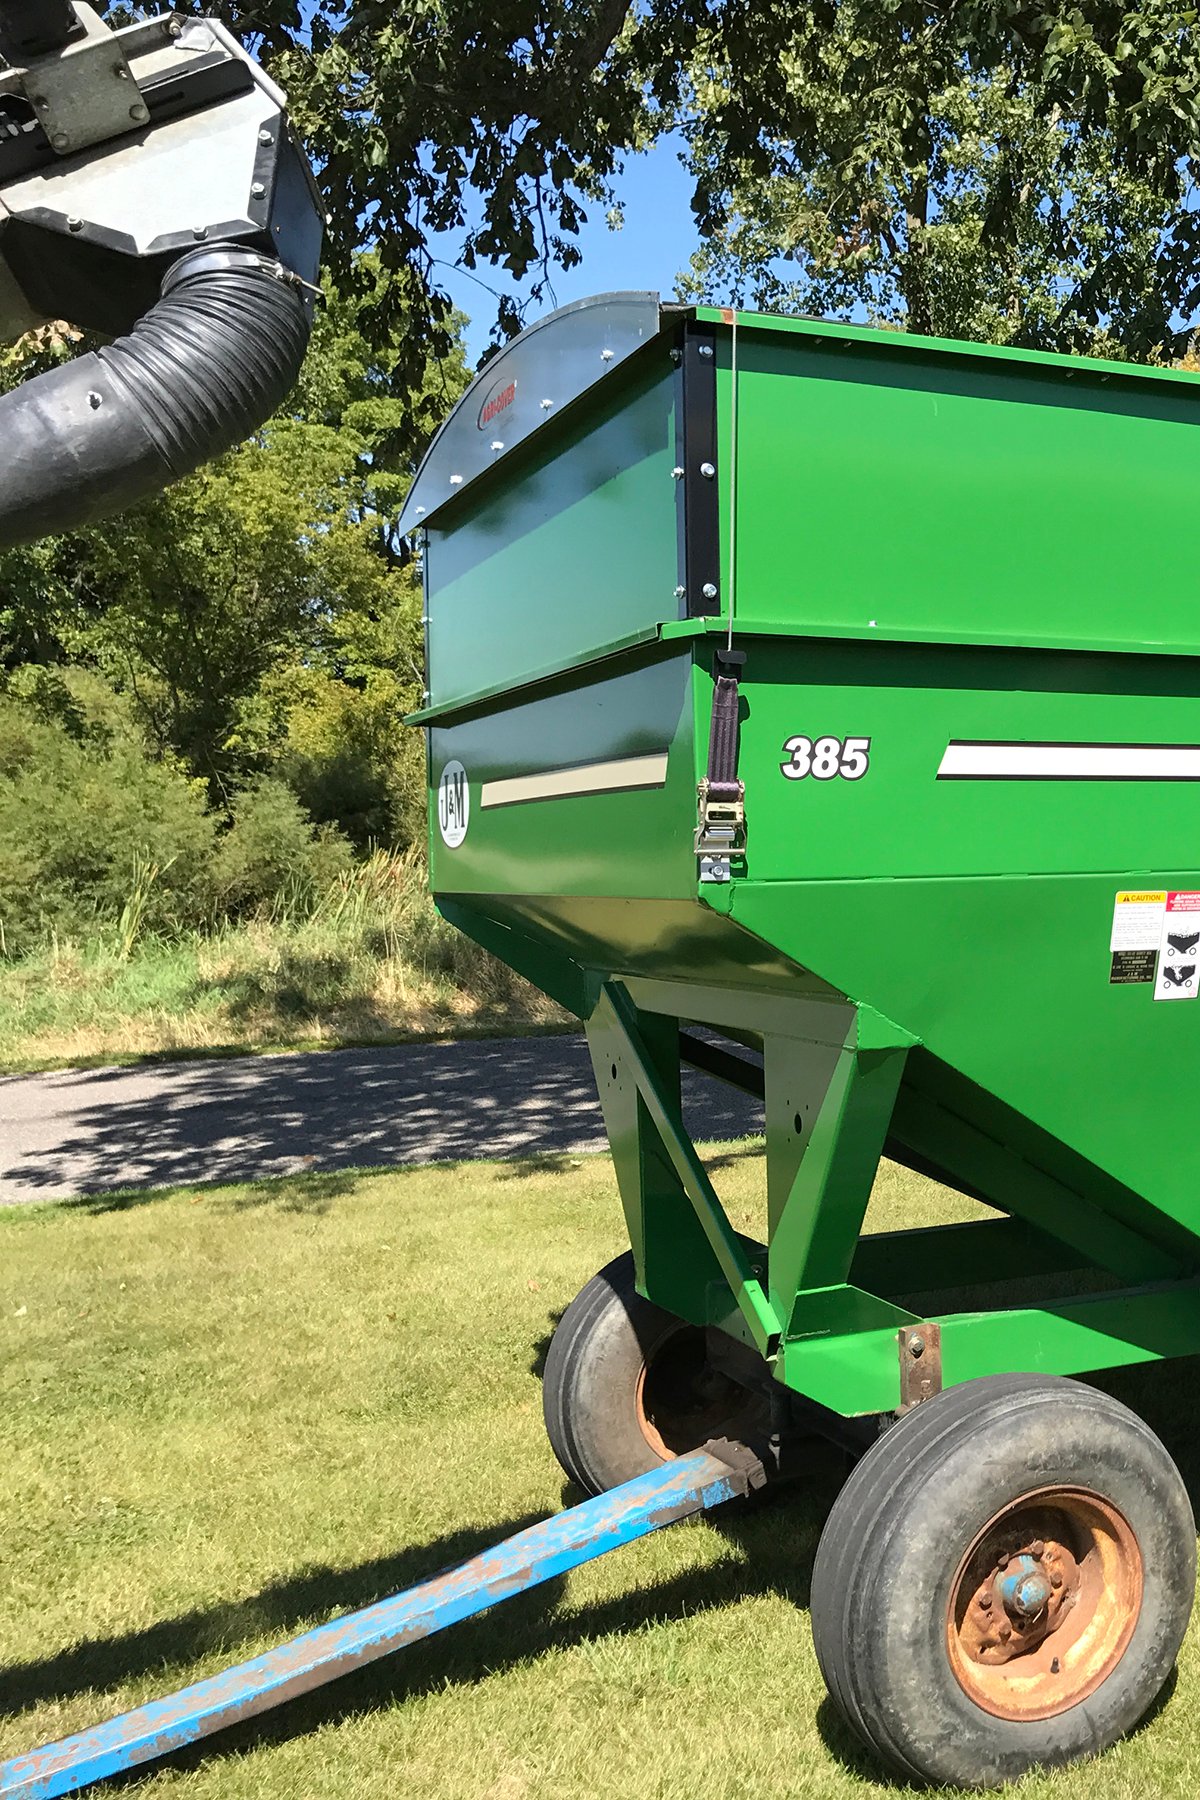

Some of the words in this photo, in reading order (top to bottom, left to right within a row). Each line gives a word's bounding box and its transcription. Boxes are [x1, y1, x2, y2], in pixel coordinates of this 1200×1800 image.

[780, 735, 872, 781] 385
[441, 771, 465, 831] J&M
[1131, 894, 1161, 902] CAUTION
